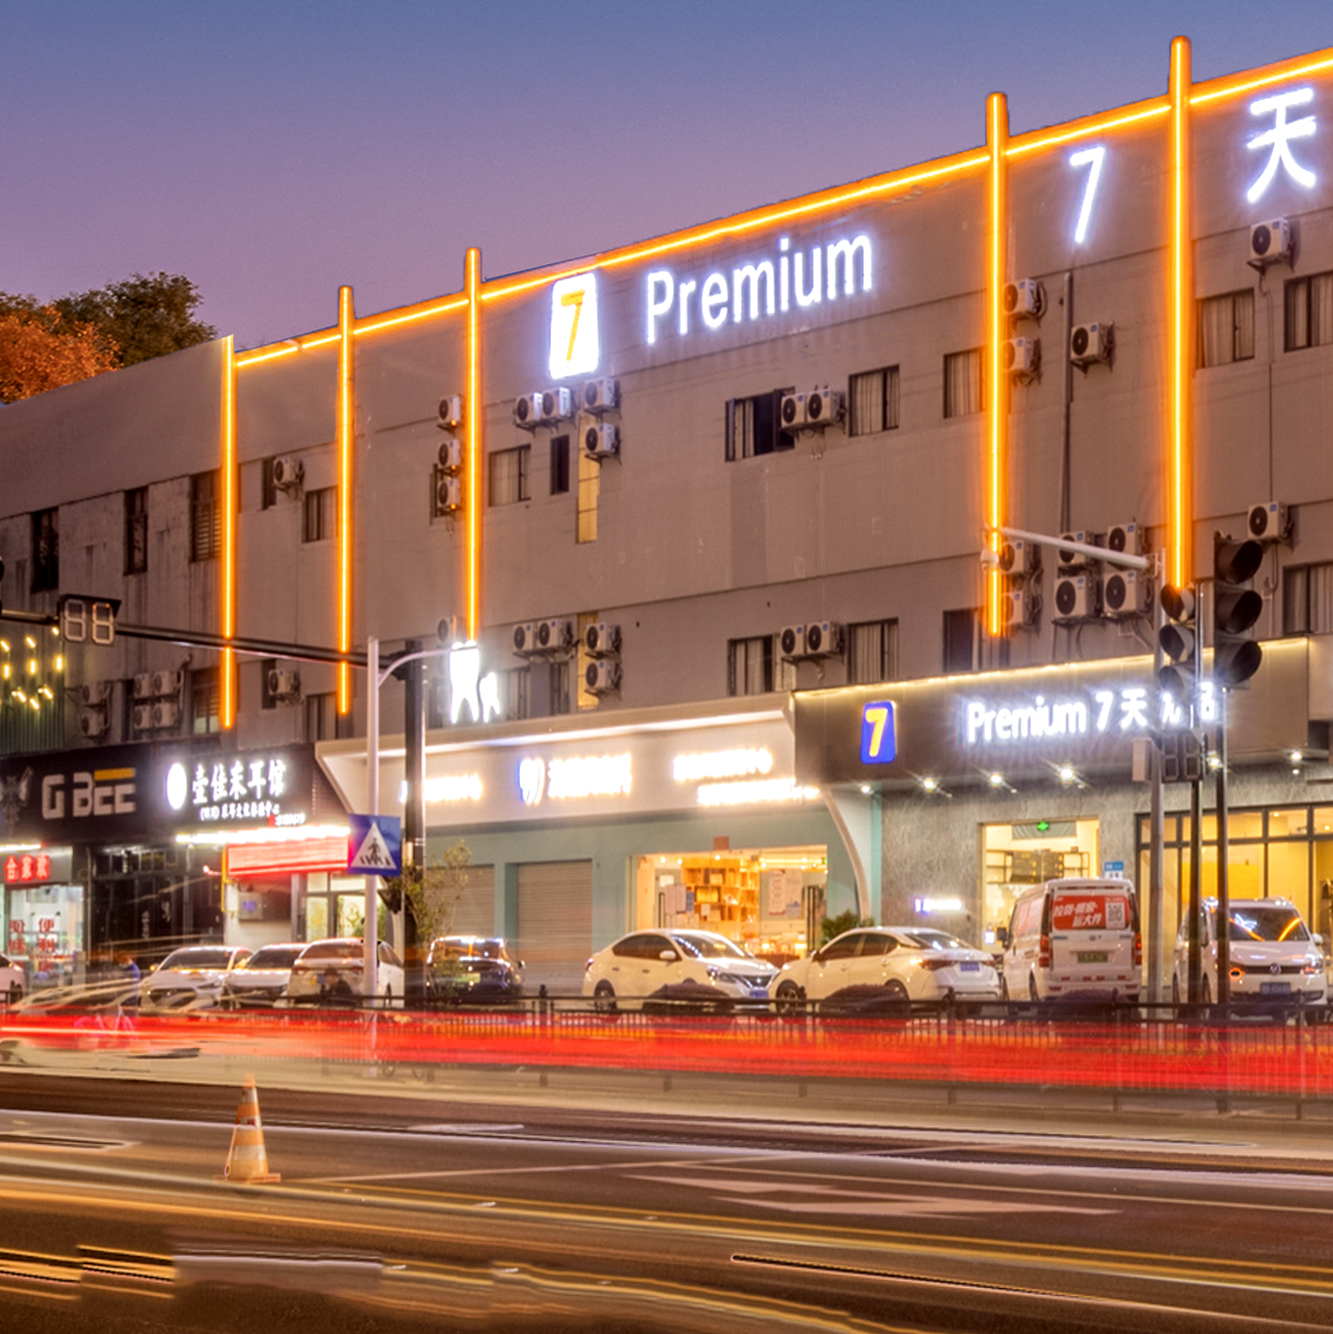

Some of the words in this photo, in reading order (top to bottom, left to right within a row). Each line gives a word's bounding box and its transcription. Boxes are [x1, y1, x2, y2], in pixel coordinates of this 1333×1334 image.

[646, 234, 873, 345] Premium
[864, 708, 888, 757] 7
[968, 695, 1087, 743] Premium
